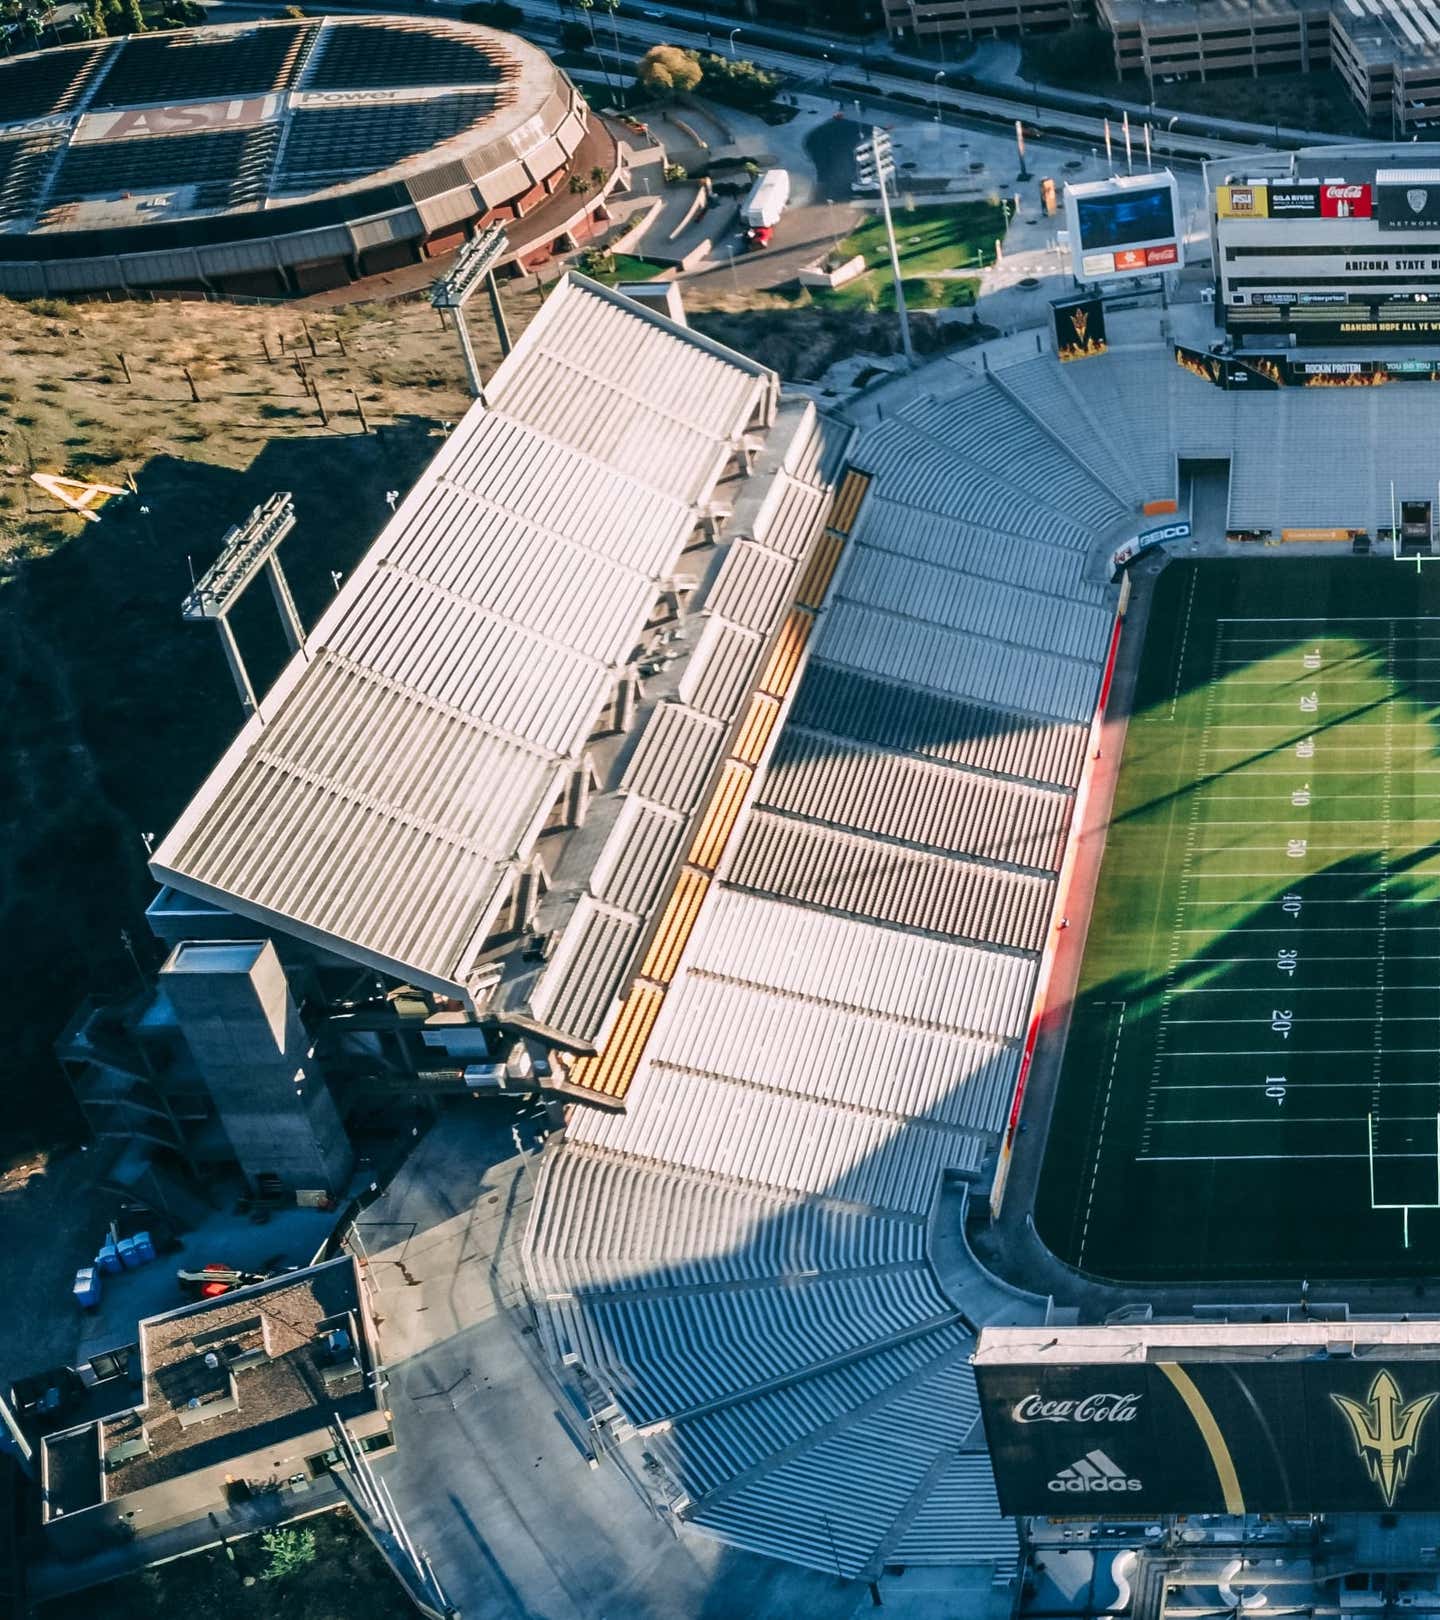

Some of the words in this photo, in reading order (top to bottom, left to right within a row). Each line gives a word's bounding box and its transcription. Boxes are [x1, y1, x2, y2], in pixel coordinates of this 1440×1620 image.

[303, 90, 400, 104] Power
[1326, 186, 1363, 198] Coca-Cola
[1345, 261, 1389, 271] ARIZONA
[1395, 260, 1425, 269] STATE
[1340, 323, 1377, 331] ABANDON
[1379, 323, 1399, 331] HOPE
[1402, 322, 1416, 330] ALL
[1418, 322, 1429, 330] YE
[1140, 525, 1190, 548] GEICO
[1301, 696, 1318, 712] 20
[1287, 839, 1306, 857] 50
[1277, 949, 1298, 970] 30
[1272, 1009, 1293, 1031] 20
[1265, 1075, 1287, 1098] 10
[1011, 1393, 1144, 1423] Coca-Cola
[1047, 1477, 1143, 1492] adidas
